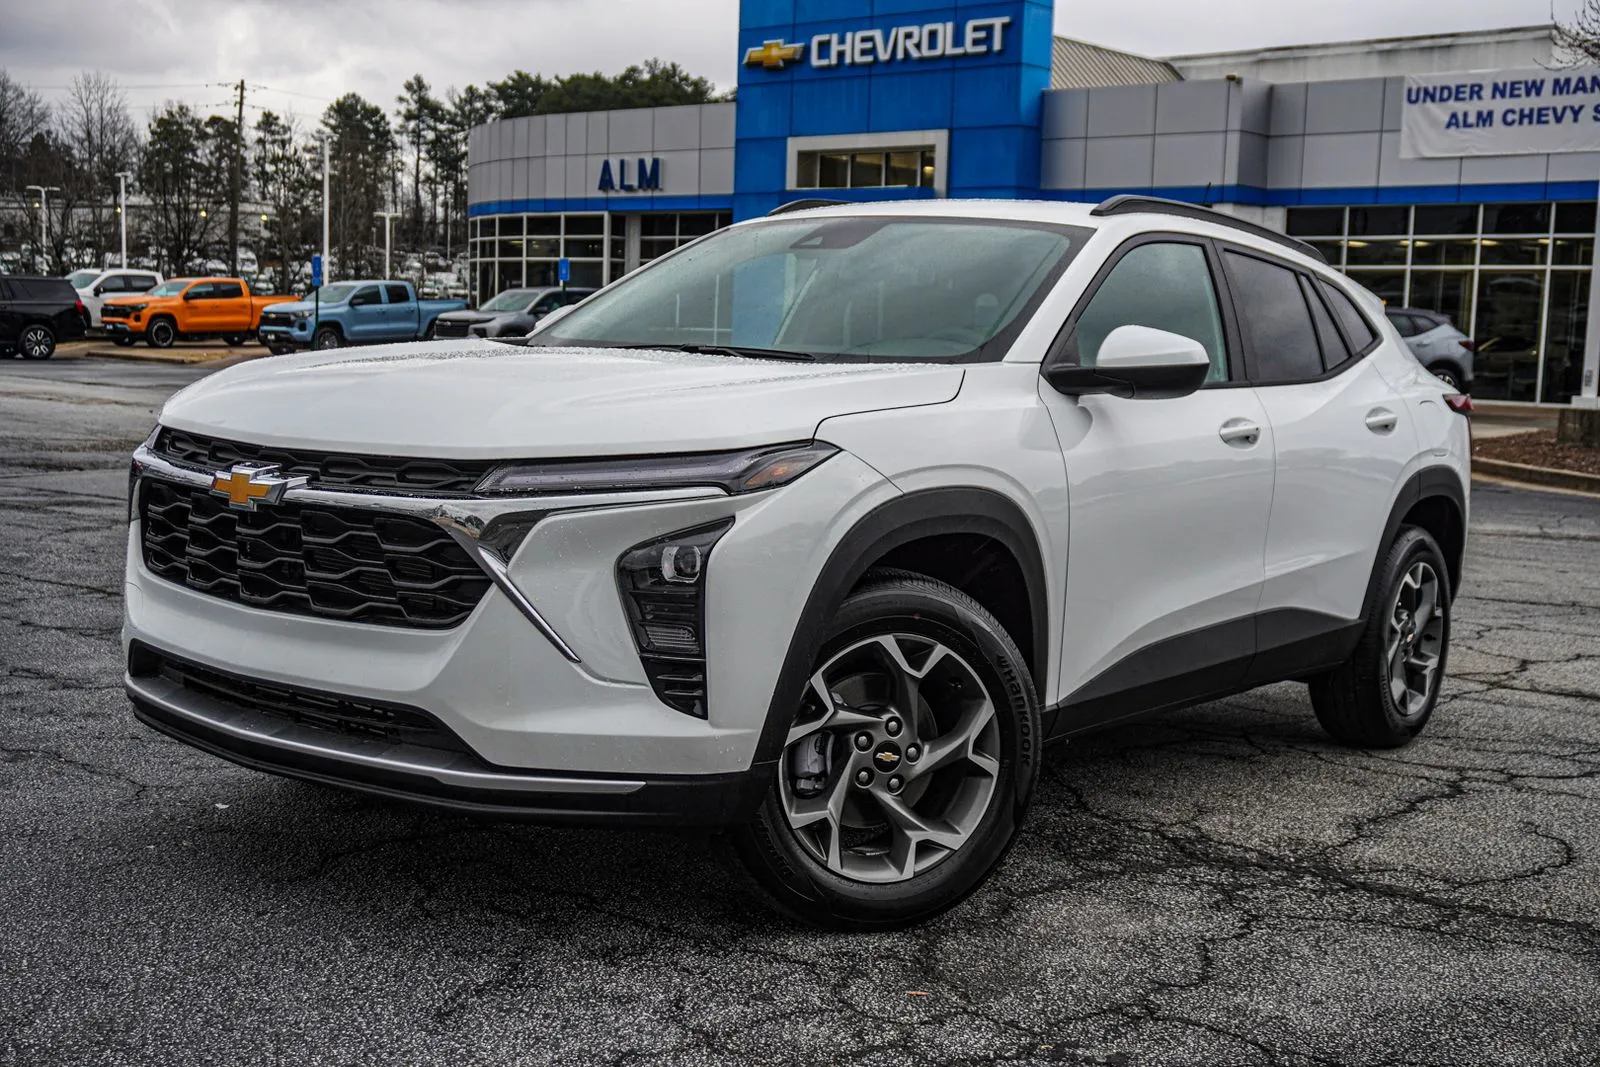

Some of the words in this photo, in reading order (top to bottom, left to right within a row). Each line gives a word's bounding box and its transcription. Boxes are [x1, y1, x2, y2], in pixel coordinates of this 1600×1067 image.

[810, 16, 1011, 67] CHEVROLET
[1406, 83, 1484, 104] UNDER
[1491, 79, 1545, 99] NEW
[1552, 75, 1600, 96] MAN
[1445, 109, 1494, 129] ALM
[1502, 104, 1585, 126] CHEVY
[598, 157, 662, 191] ALM
